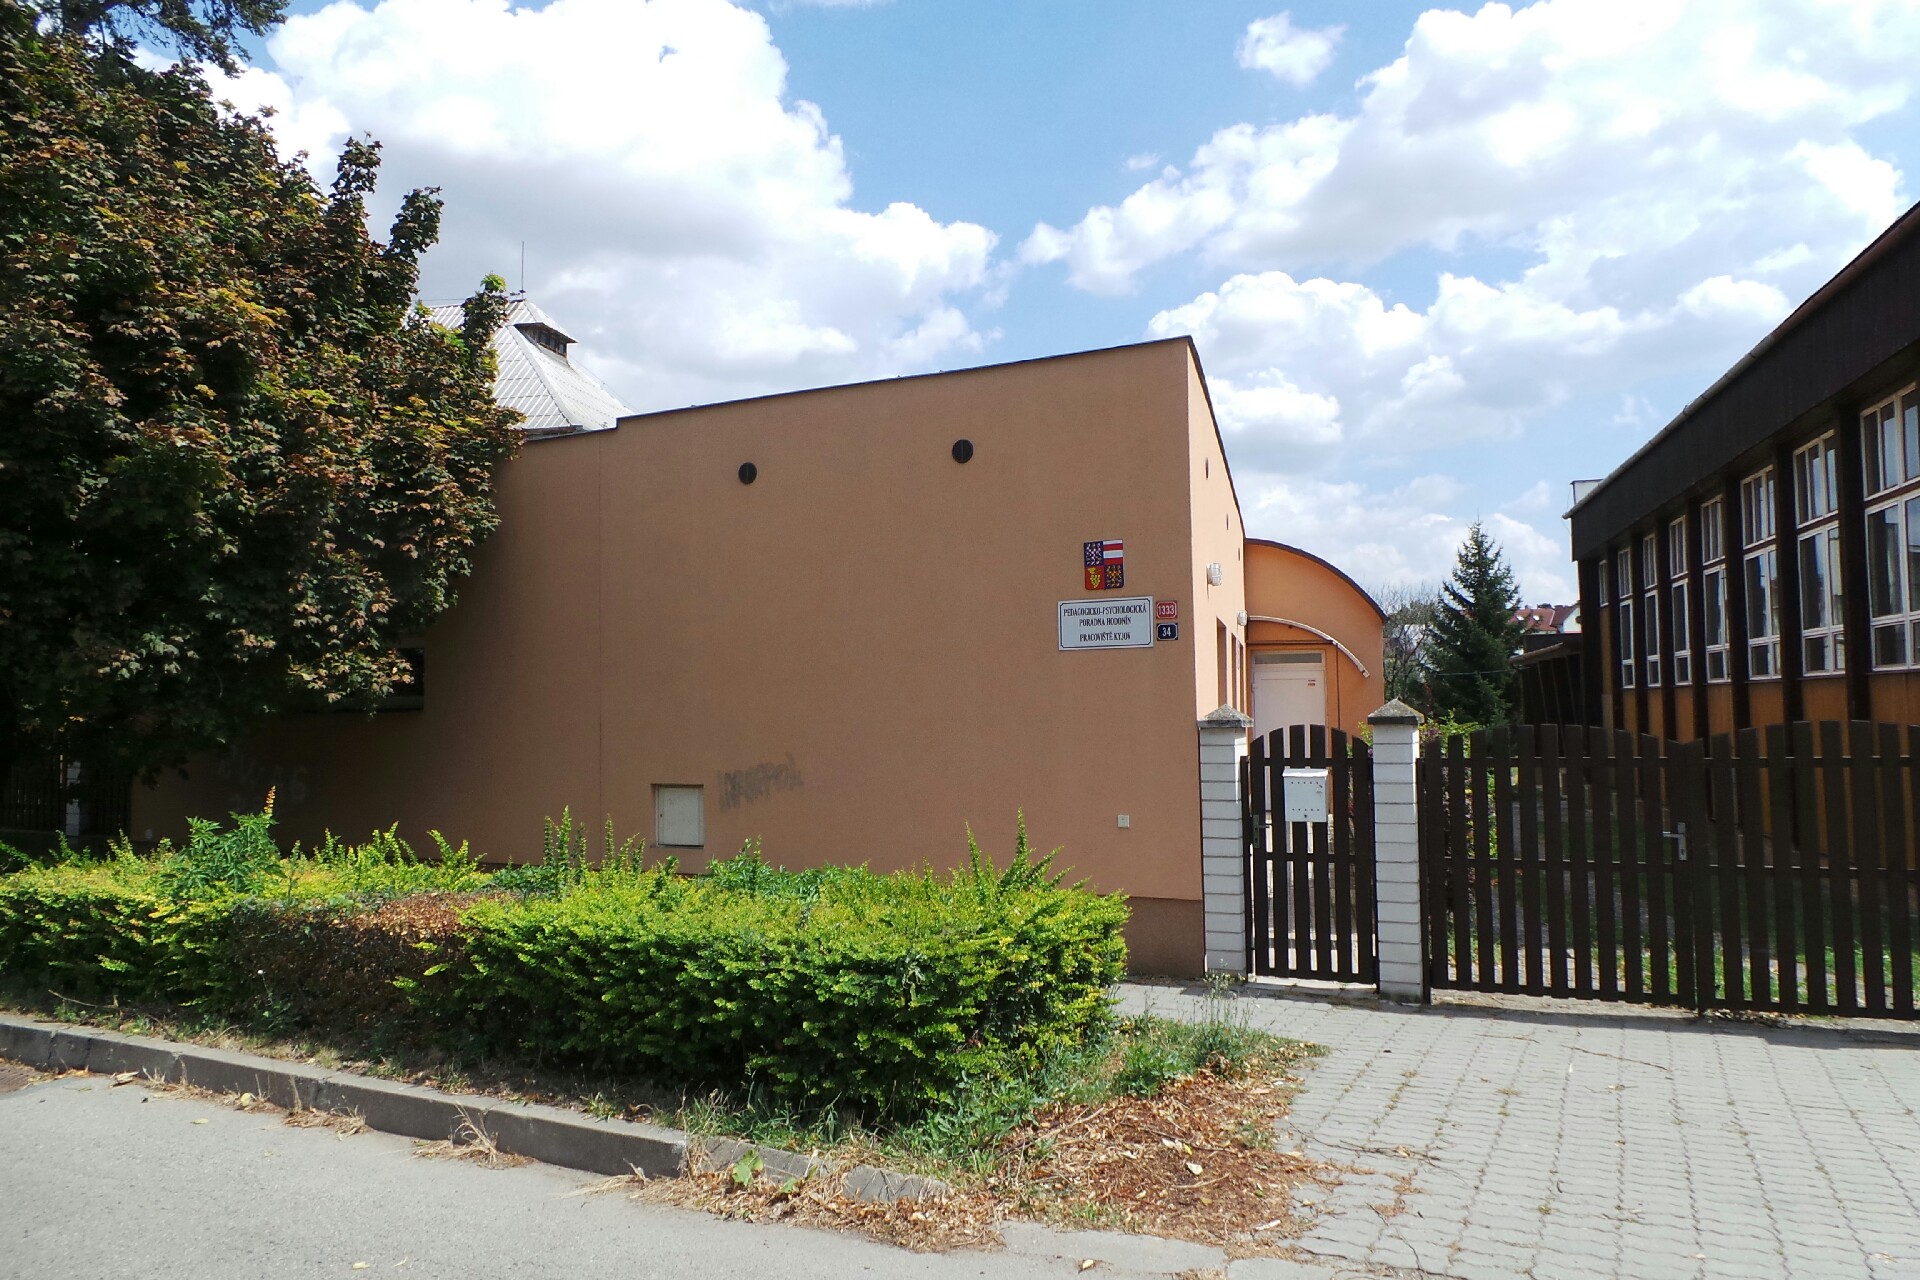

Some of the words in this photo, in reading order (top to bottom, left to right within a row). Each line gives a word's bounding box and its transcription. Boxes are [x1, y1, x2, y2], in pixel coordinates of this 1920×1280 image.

[1158, 605, 1174, 616] 1333
[1079, 617, 1105, 627] PORADNA
[1106, 615, 1131, 626] HODONÍN
[1079, 631, 1113, 642] PRACOVIŠTĚ
[1114, 632, 1131, 641] KYJOV
[1162, 627, 1171, 637] 34
